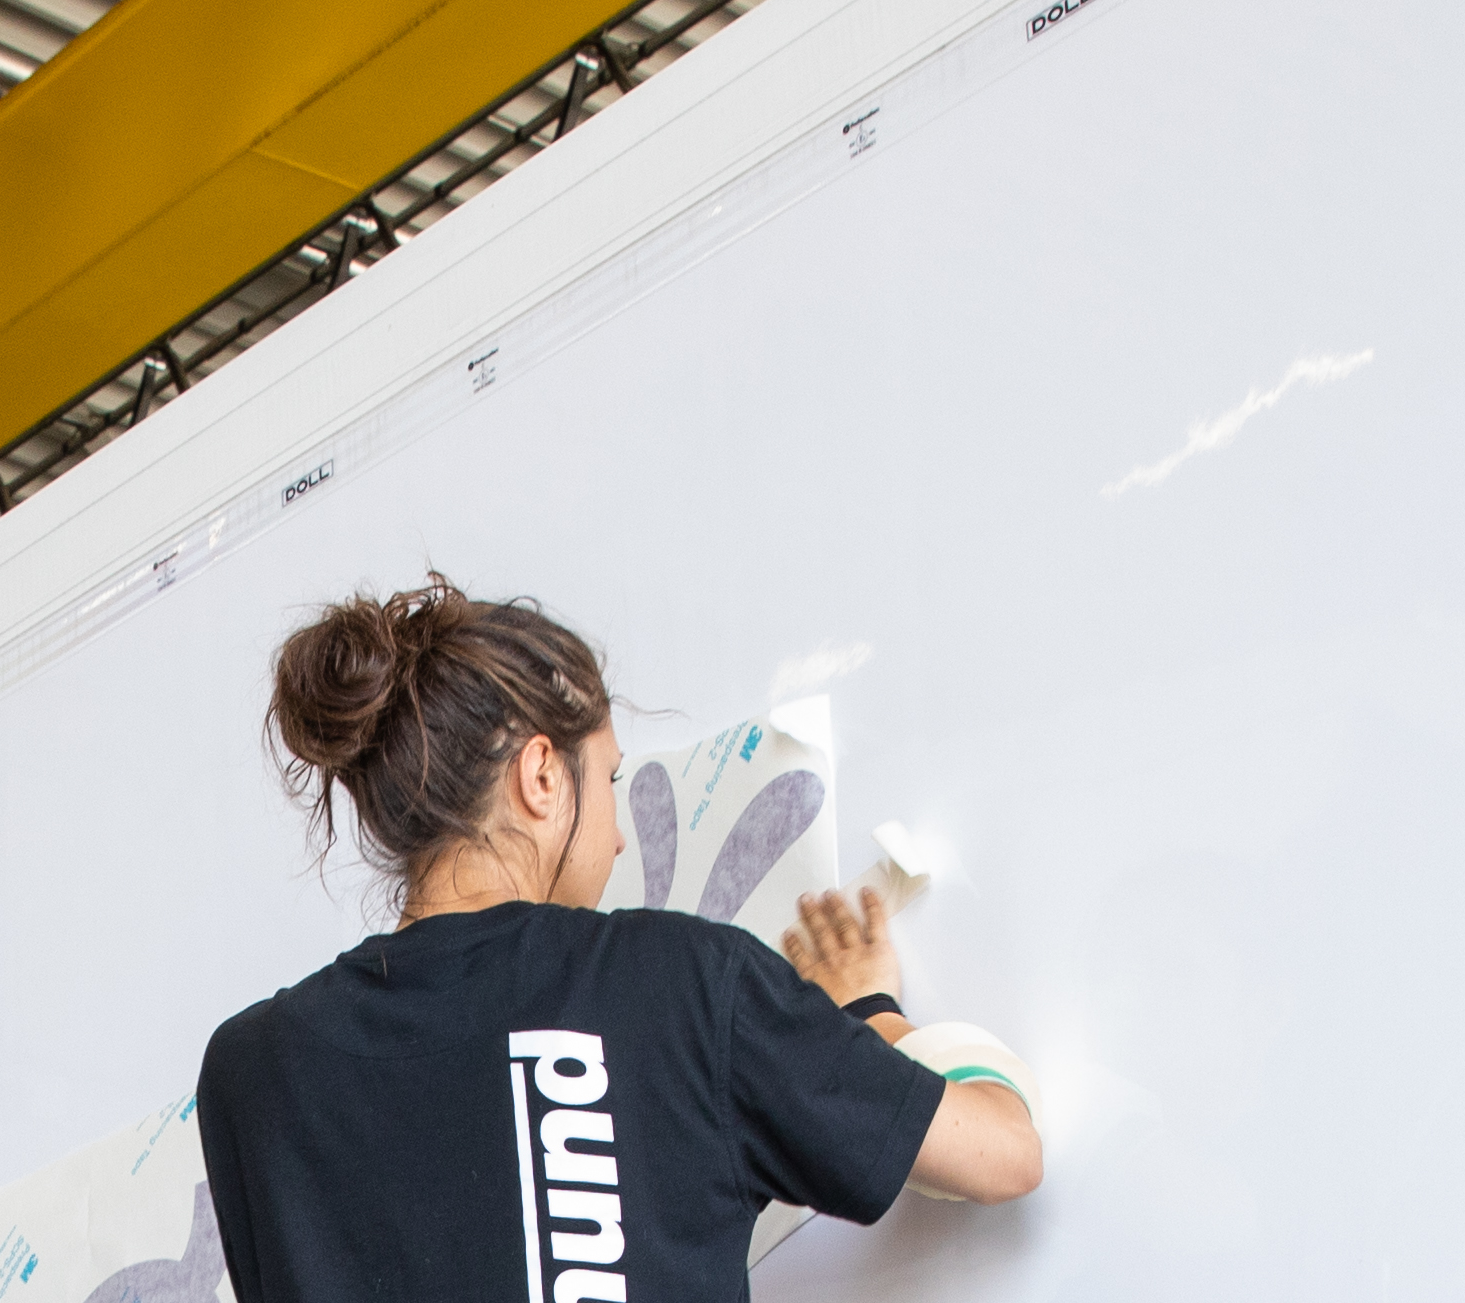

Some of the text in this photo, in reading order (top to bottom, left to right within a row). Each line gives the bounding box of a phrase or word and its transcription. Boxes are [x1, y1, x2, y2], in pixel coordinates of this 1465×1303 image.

[1032, 0, 1086, 34] DOL
[285, 467, 330, 502] DOLL
[739, 725, 763, 763] 3M
